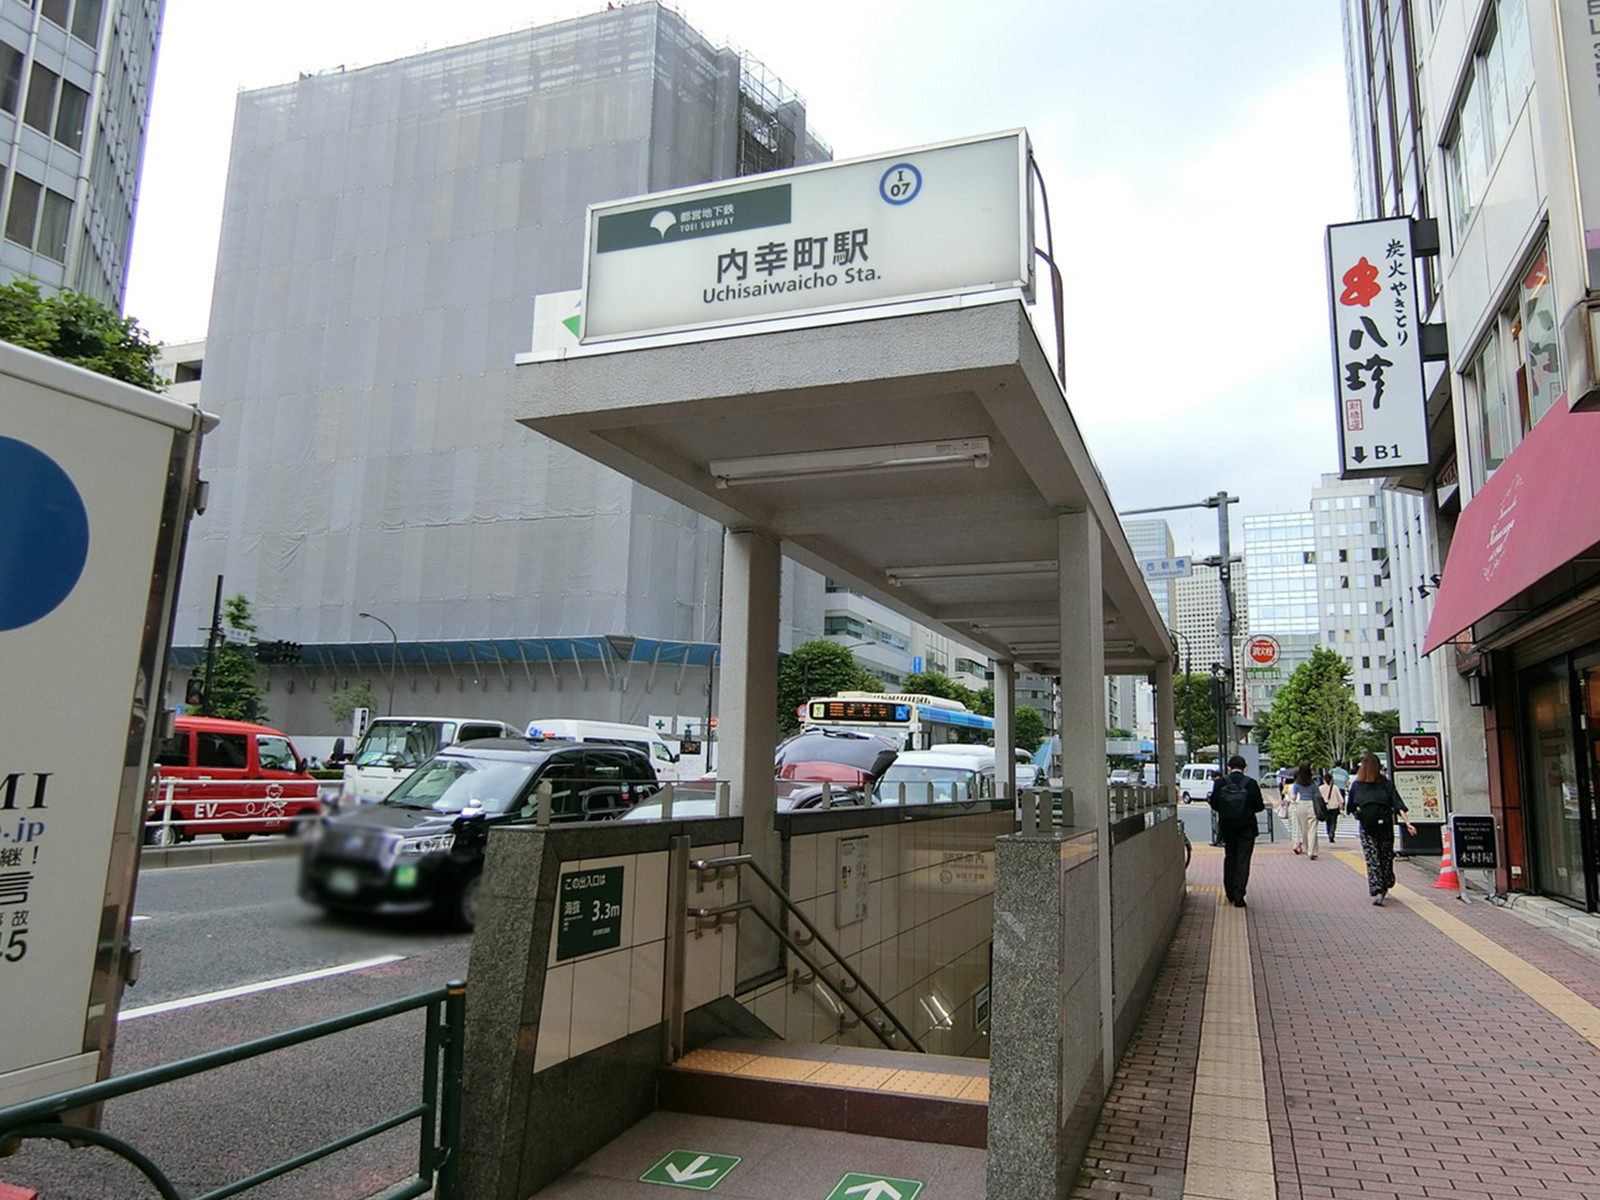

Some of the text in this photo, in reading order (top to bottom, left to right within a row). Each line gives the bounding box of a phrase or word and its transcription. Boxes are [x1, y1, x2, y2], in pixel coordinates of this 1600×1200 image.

[896, 170, 904, 182] I
[890, 182, 911, 198] 07
[680, 203, 735, 222] 都営地下鉄
[680, 216, 735, 233] TOEI SUBWAY
[716, 228, 870, 284] 内幸町駅
[703, 266, 882, 304] Uchisaiwaicho Sta.
[1385, 238, 1408, 346] 炭火やきとり
[1374, 444, 1402, 460] B1
[1394, 745, 1437, 759] VOLKS
[194, 803, 218, 818] EV
[565, 874, 607, 890] この出入口は
[592, 900, 620, 922] 3.3m
